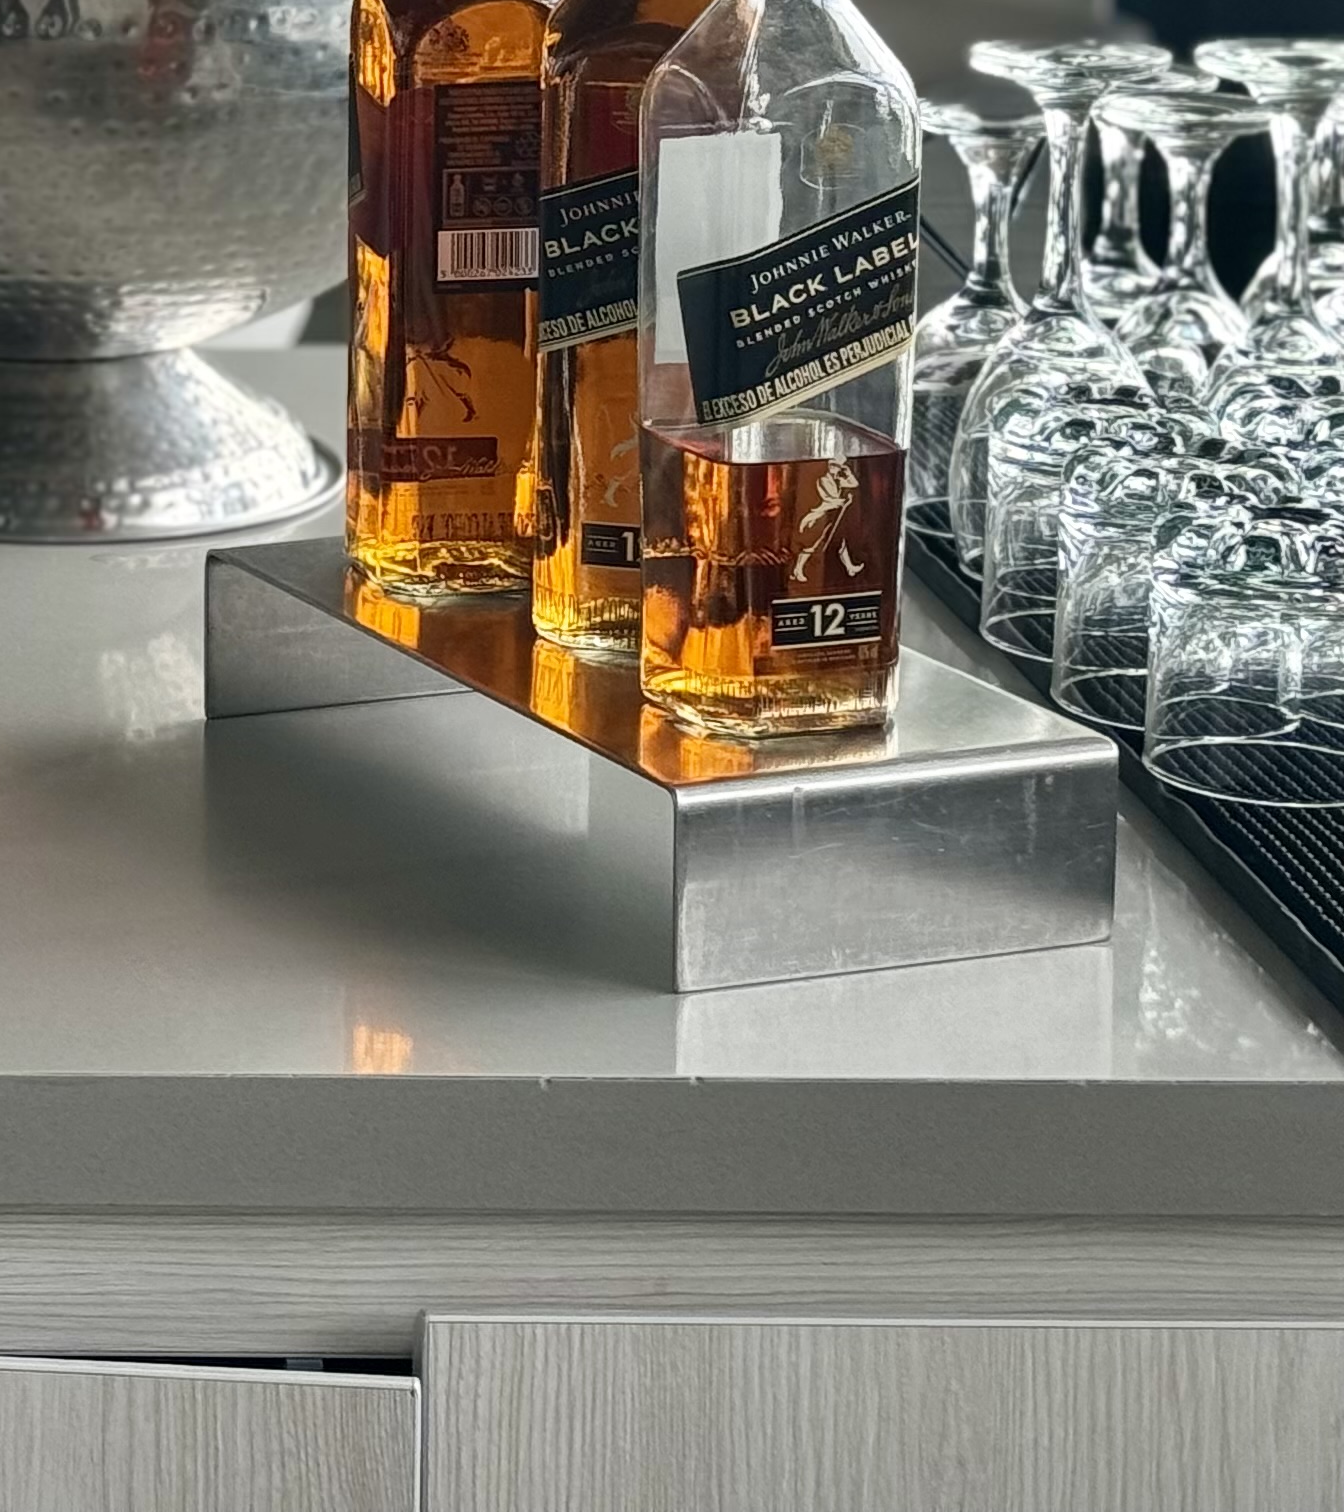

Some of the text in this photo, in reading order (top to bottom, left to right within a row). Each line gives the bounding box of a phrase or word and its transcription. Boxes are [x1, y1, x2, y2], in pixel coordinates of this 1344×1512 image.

[544, 217, 639, 259] BLACK
[749, 209, 907, 295] JOHNNIE WALKER
[547, 252, 613, 278] BLENDED
[729, 231, 919, 328] BLACK LABEL
[568, 311, 587, 334] DE
[586, 298, 639, 331] ALCOHOL
[736, 314, 801, 349] BLENDED
[808, 287, 862, 318] SCOTCH
[712, 388, 757, 419] EXCESO
[758, 381, 775, 403] DE
[775, 360, 826, 398] ALCOHOL
[825, 354, 840, 377] ES
[841, 323, 910, 371] PERJUDICIAL
[622, 531, 640, 562] 1
[810, 602, 846, 637] 12
